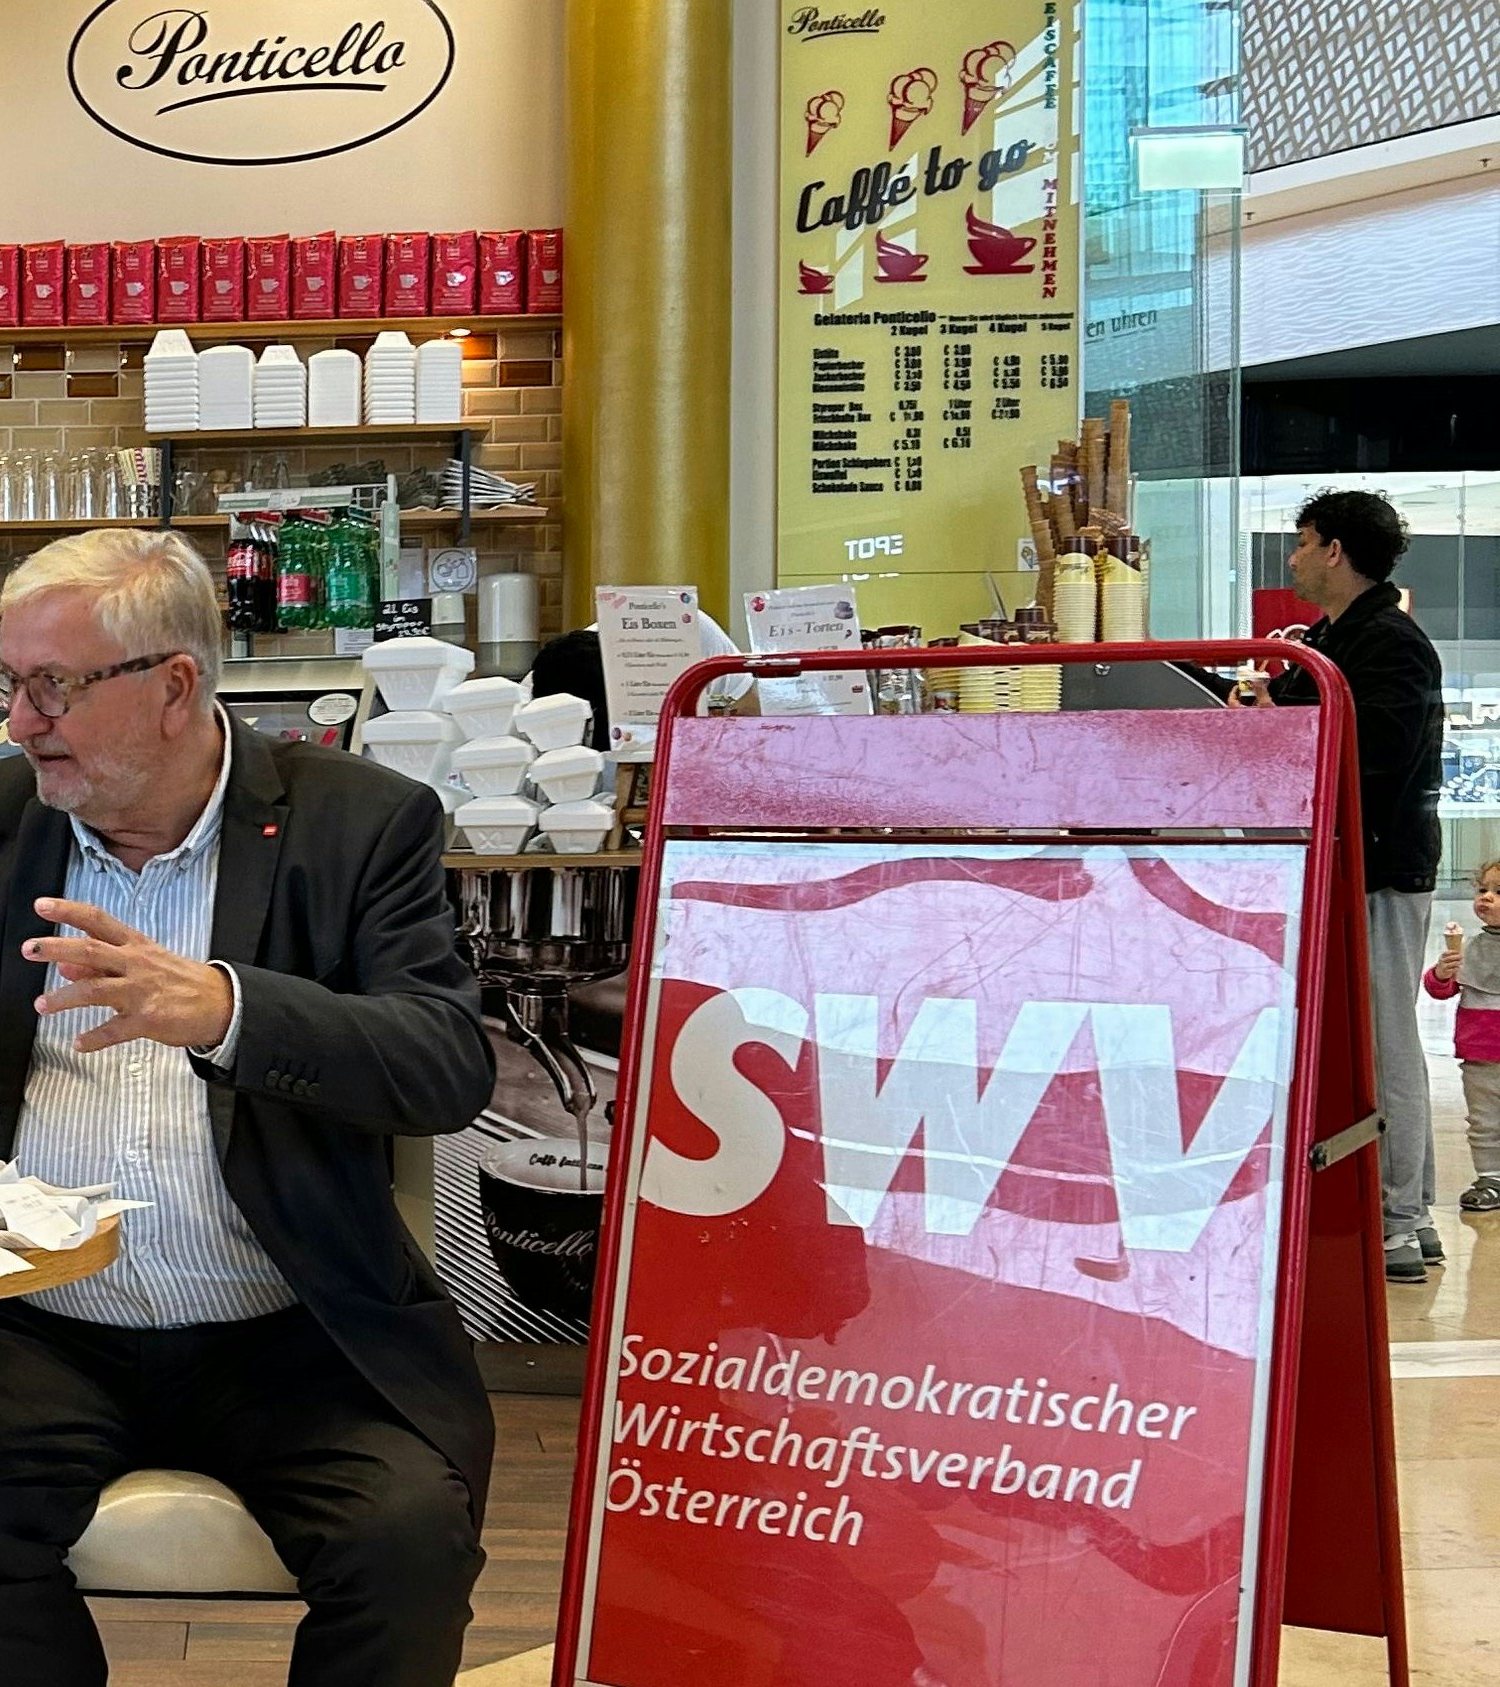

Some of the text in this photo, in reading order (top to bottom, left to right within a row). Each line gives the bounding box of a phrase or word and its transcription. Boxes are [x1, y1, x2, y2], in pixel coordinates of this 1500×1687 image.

[787, 7, 886, 34] Ponticello
[116, 9, 407, 90] Ponticello
[924, 145, 972, 197] to
[978, 137, 1036, 194] go
[1041, 179, 1058, 299] MITNEHMEN
[814, 312, 871, 326] Gelateria
[873, 310, 936, 324] Ponticello
[891, 325, 928, 336] 2 Kugel
[940, 323, 978, 334] 3 Kugel
[989, 322, 1027, 333] 4 Kugel
[1049, 322, 1071, 331] Kugel
[1112, 310, 1157, 332] uhren
[621, 617, 676, 629] Eis Boxen
[639, 986, 1298, 1253] SWV
[483, 1206, 595, 1257] Ponticello
[619, 1334, 1197, 1442] Sozialdemokratischer
[612, 1400, 1141, 1511] Wirtschaftsverband
[604, 1459, 865, 1547] Österreich
